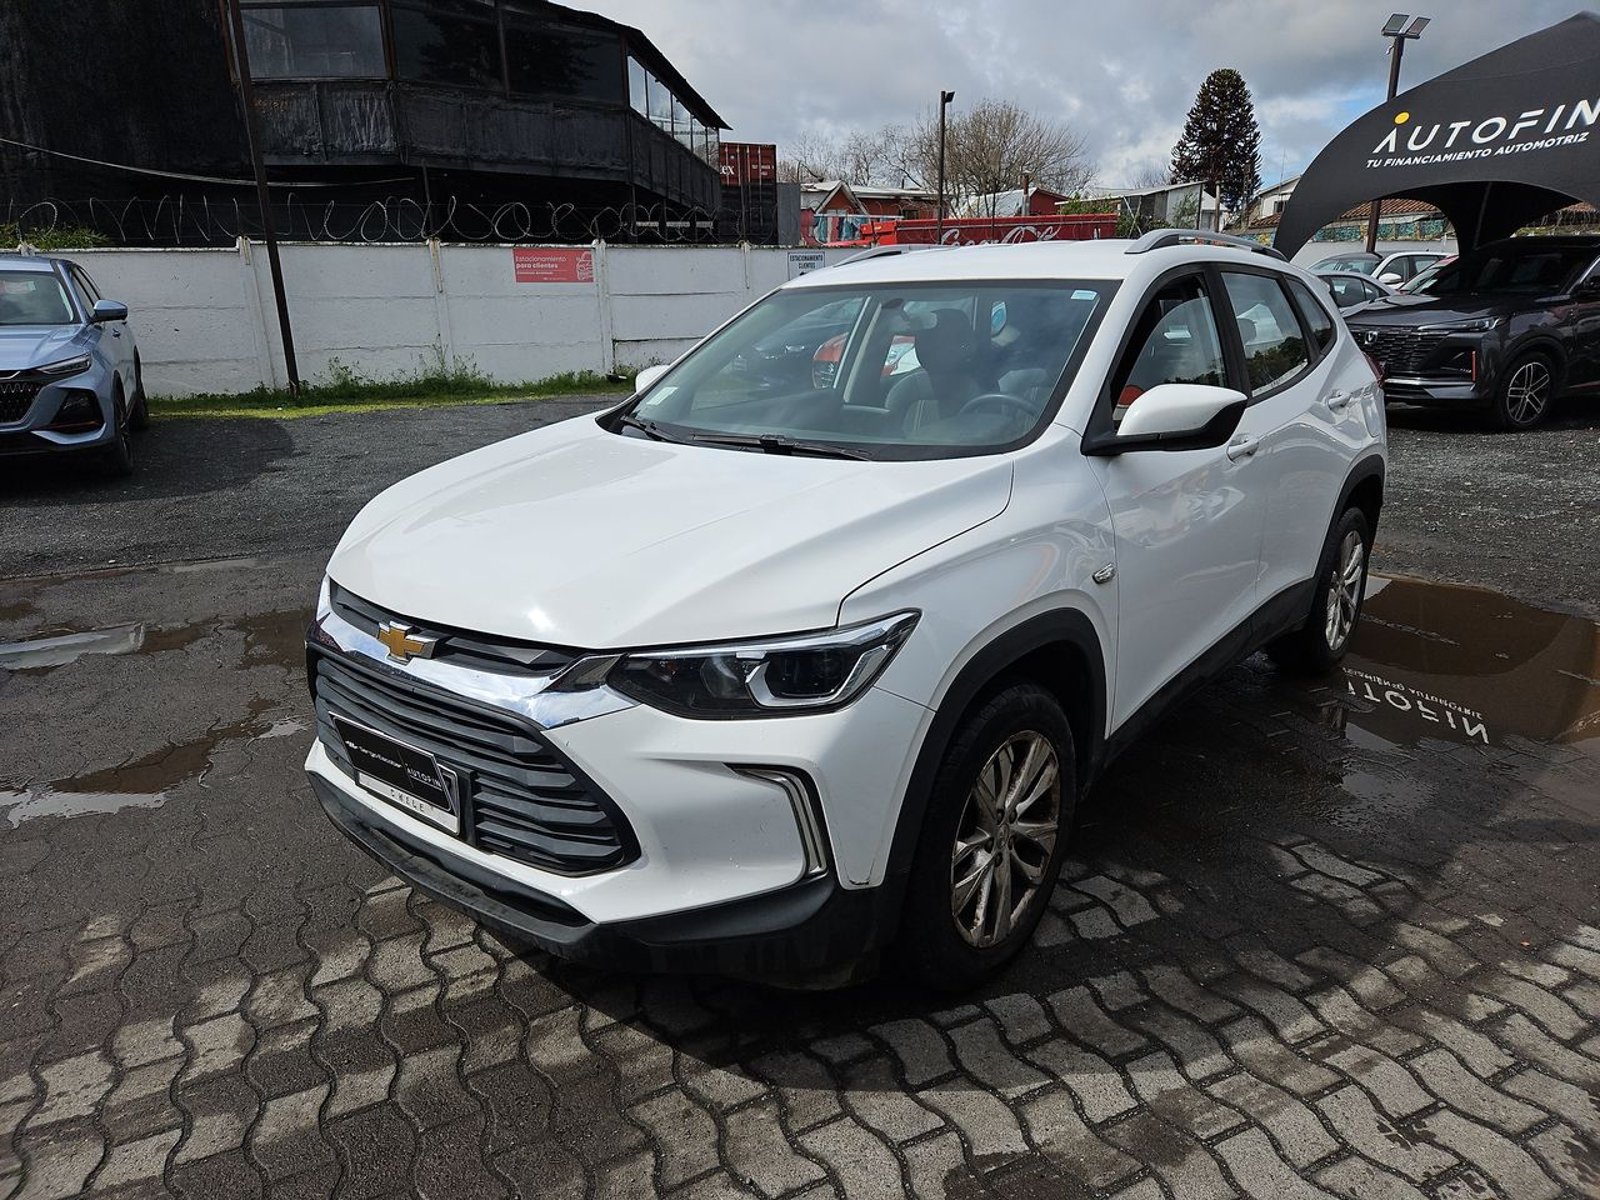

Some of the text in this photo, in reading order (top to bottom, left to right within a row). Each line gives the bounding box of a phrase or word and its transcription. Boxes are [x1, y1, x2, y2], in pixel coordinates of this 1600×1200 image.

[1372, 98, 1600, 154] AUTOFIN
[1366, 132, 1590, 168] TU FINANCIAMIENTO AUTOMOTRIZ
[515, 255, 567, 263] Estacionamiento
[790, 254, 823, 262] ESTACIONAMIENTO
